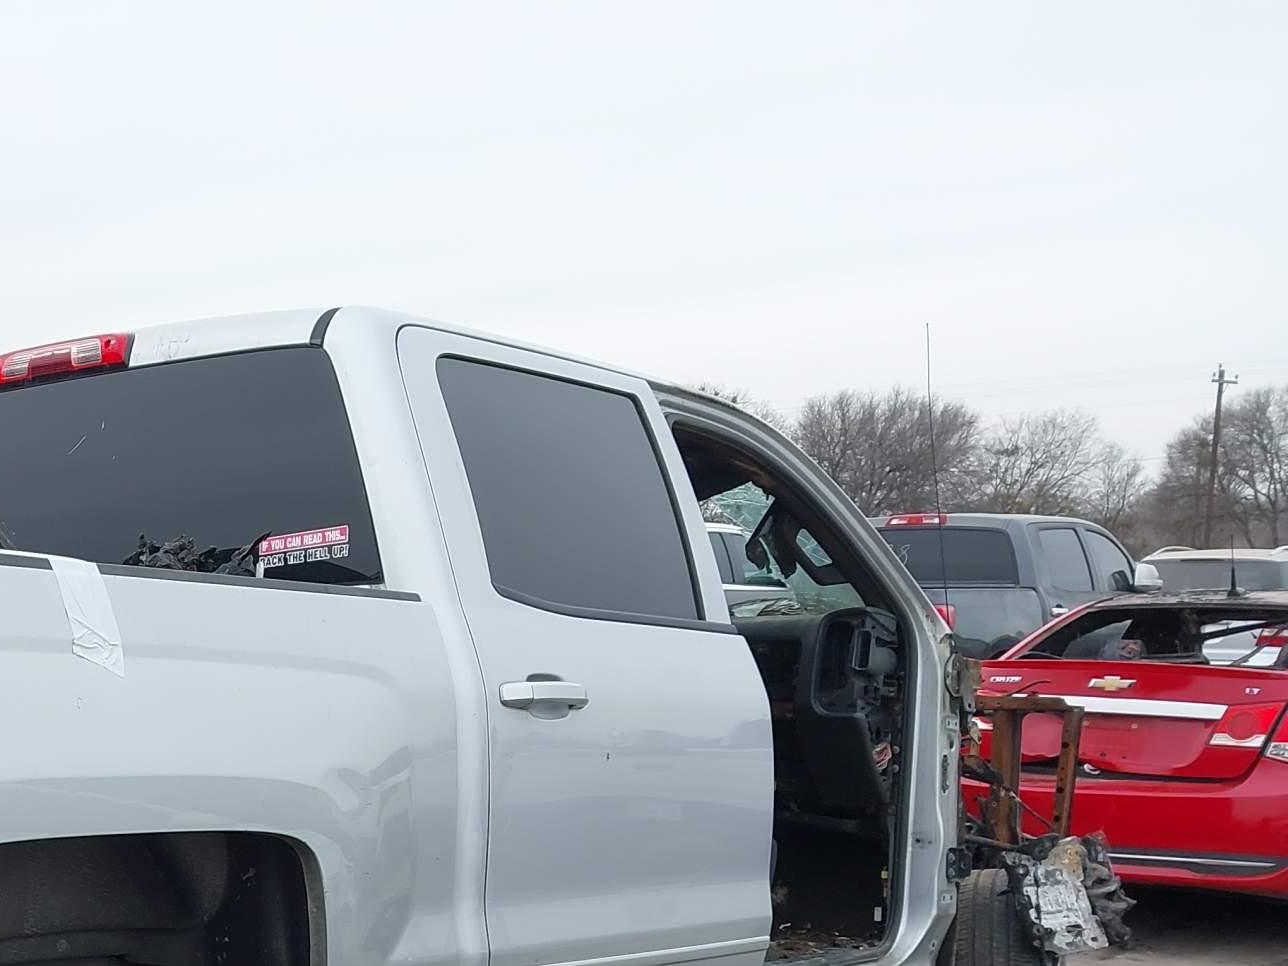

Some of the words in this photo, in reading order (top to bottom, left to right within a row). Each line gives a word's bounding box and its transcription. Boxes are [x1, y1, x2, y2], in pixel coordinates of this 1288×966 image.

[262, 541, 269, 552] IF
[271, 540, 285, 550] YOU
[286, 536, 302, 547] CAN
[303, 532, 322, 545] READ
[286, 551, 304, 564] THE
[306, 547, 330, 562] HELL
[332, 544, 349, 558] UP!
